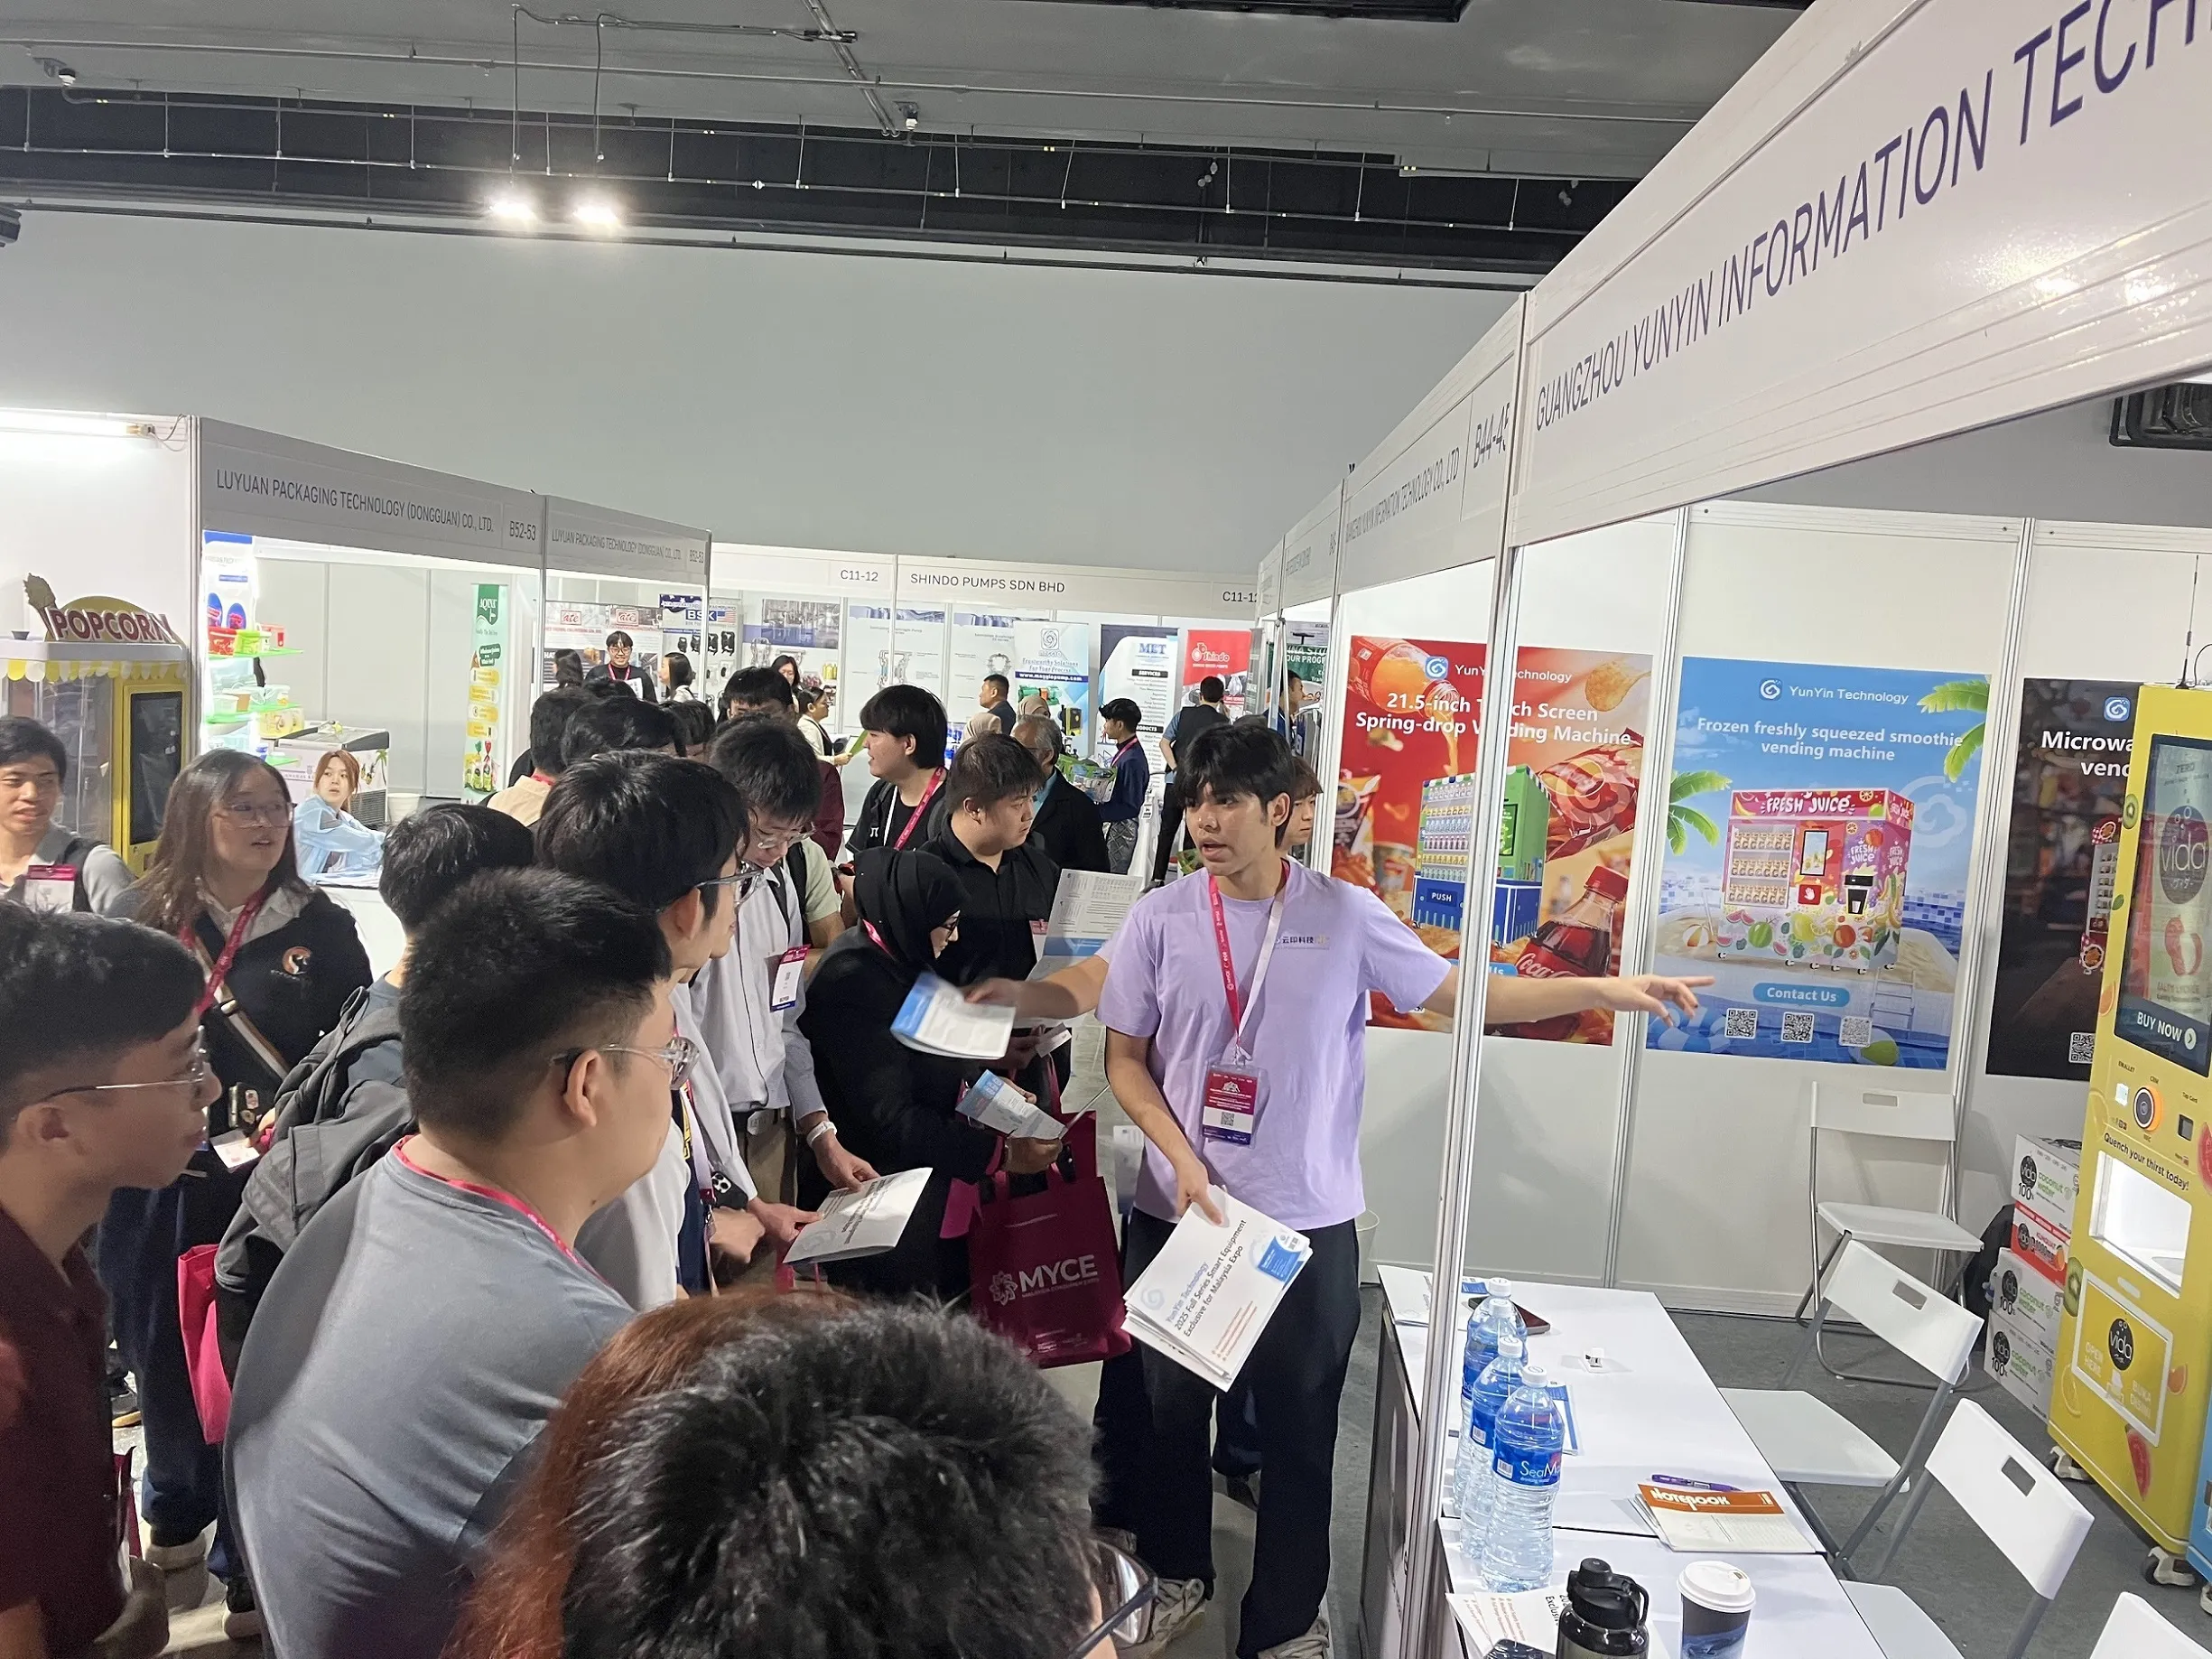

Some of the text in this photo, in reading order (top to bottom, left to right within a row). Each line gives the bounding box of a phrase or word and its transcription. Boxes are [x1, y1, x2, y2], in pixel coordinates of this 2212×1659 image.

[1537, 0, 2212, 432] GUANGZHOU YUNYIN INFORMATION TECH
[217, 469, 494, 532] LUYUAN PACKAGING TECHNOLOGY (DONGGUAN) CO., LTD.
[509, 520, 536, 541] B52-53
[552, 528, 575, 543] LUYUAN
[575, 531, 606, 549] PACKAGING
[606, 537, 637, 554] TECHNOLOGY
[841, 570, 878, 582] C11-12
[910, 573, 1064, 593] SHINDO PUMPS SDN BHD
[46, 607, 176, 643] POPCORN
[1139, 643, 1166, 655] MET
[1302, 656, 1324, 664] PROG
[1455, 664, 1572, 684] YunY echnology
[1789, 685, 1909, 704] YunYin Technology
[1387, 693, 1471, 713] 21.5-inch
[1538, 704, 1598, 722] Screen
[1356, 713, 1631, 745] Spring-drop Vding Machine
[1697, 717, 1964, 747] Frozen freshly squeezed smoothie
[1761, 741, 1895, 761] vending machine
[2041, 730, 2134, 752] Microwa
[1767, 795, 1851, 814] FRESH JUICE
[1851, 844, 1873, 853] FRESH
[1431, 892, 1452, 902] PUSH
[1767, 987, 1837, 1002] Contact Us
[2137, 1011, 2183, 1042] BUY NOW
[2104, 1132, 2129, 1155] Quench
[2129, 1150, 2146, 1164] your
[2146, 1156, 2165, 1177] thirst
[2166, 1170, 2189, 1191] today!
[1018, 1254, 1098, 1292] MYCE
[1175, 1314, 1189, 1331] 2025
[1194, 1277, 1211, 1302] Series
[1206, 1257, 1224, 1279] Smart
[1221, 1219, 1248, 1257] Equipment
[1183, 1245, 1243, 1337] Exclusive for Malaysia Expo
[2086, 1341, 2104, 1362] OPEN
[2110, 1330, 2133, 1360] vida
